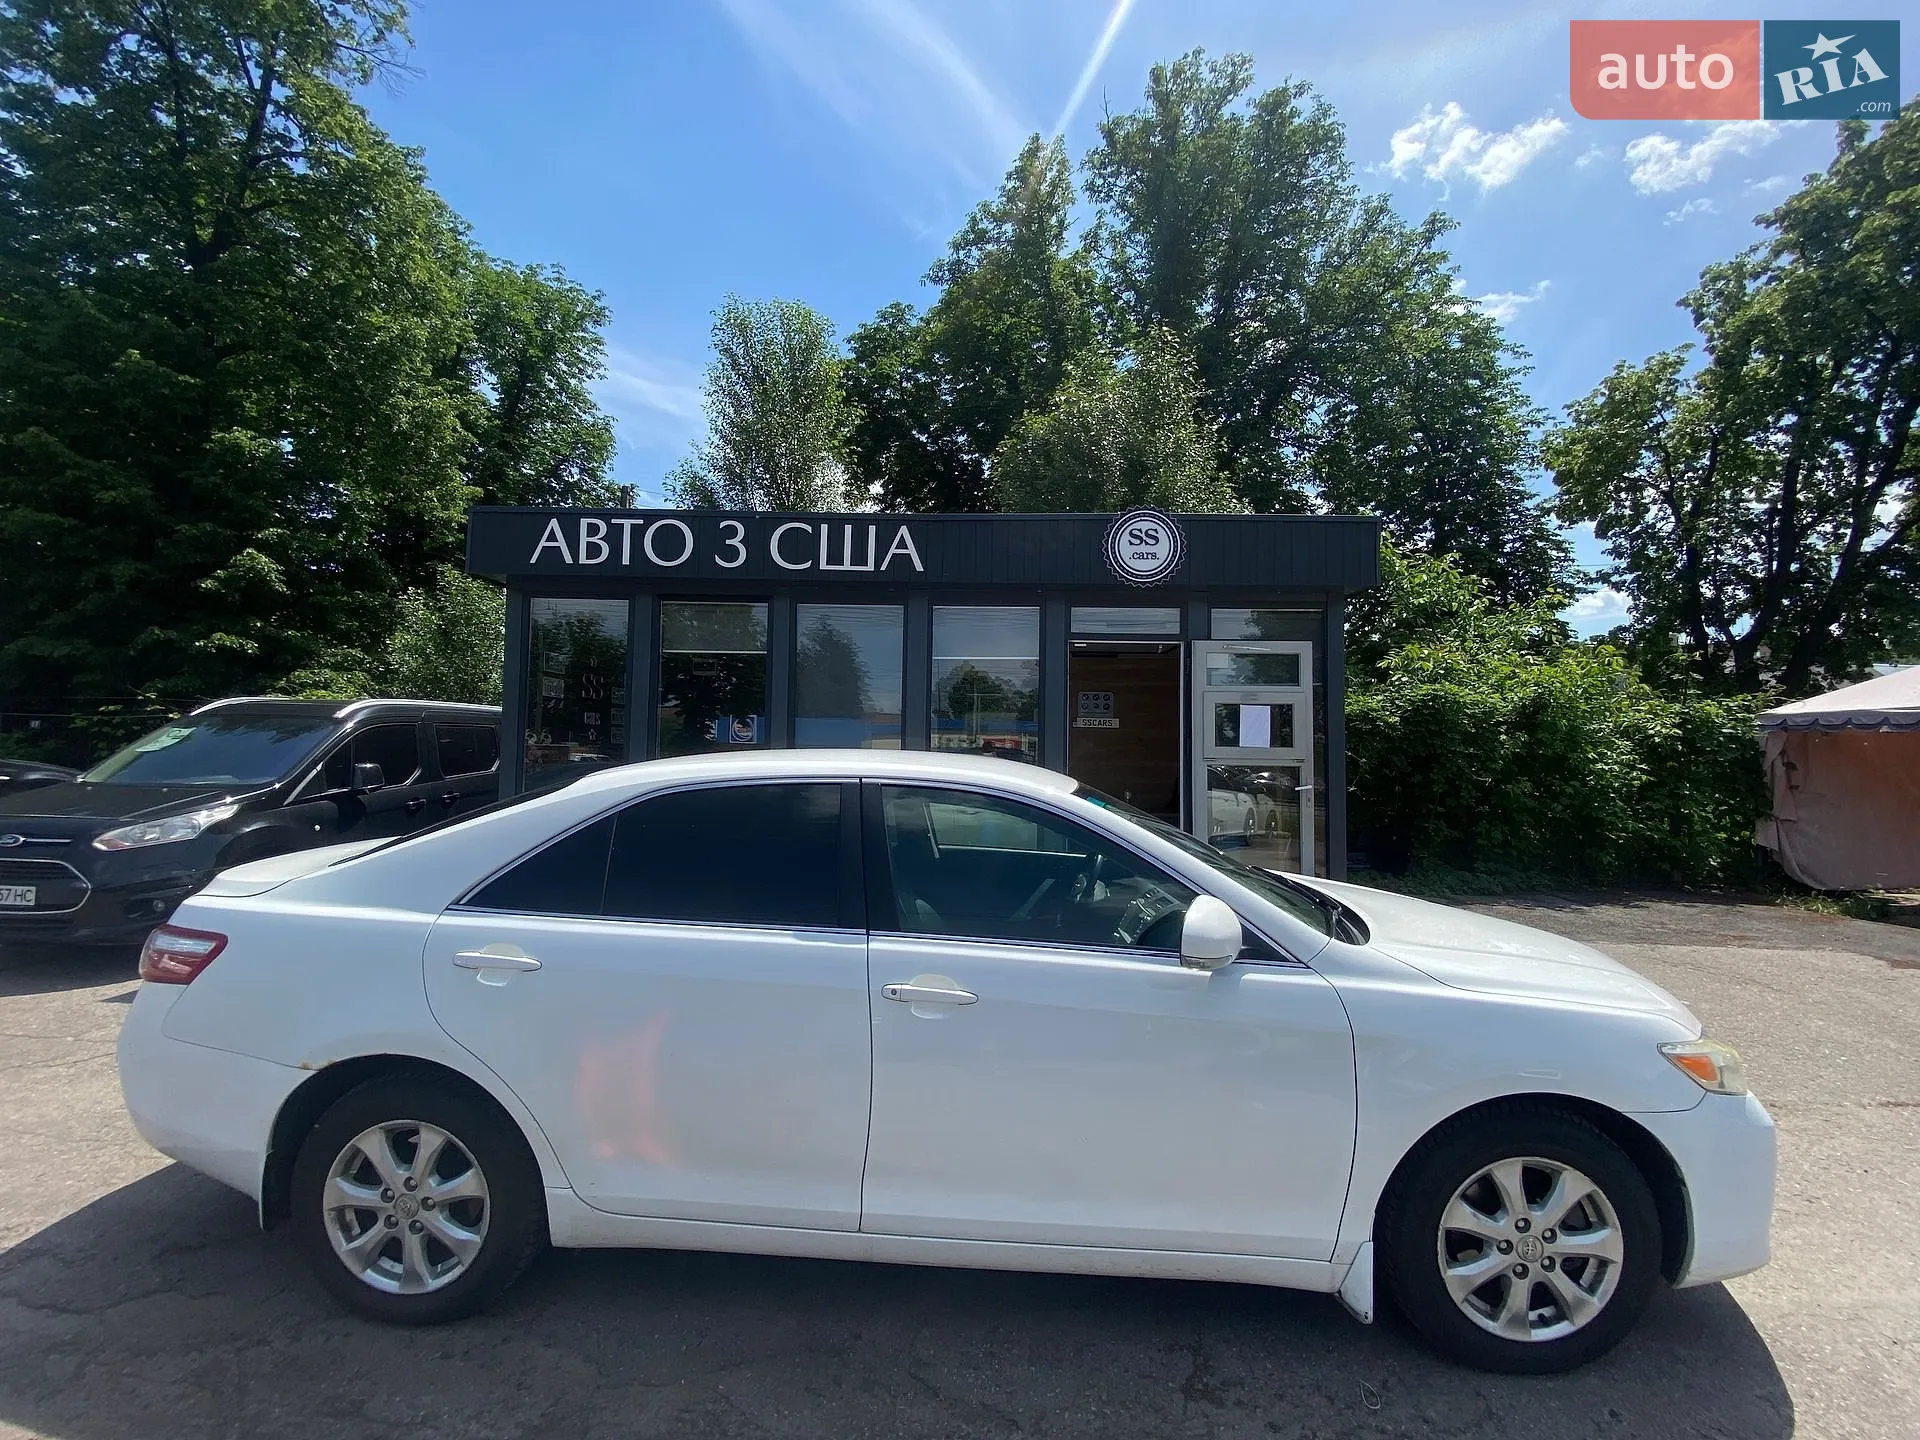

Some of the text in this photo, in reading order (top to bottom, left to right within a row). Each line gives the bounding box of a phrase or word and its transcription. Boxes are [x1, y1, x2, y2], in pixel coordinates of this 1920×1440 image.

[529, 518, 694, 567] АВТО
[769, 522, 925, 572] США
[1128, 528, 1160, 546] SS
[1082, 719, 1113, 727] SSCARS
[14, 888, 33, 903] HC
